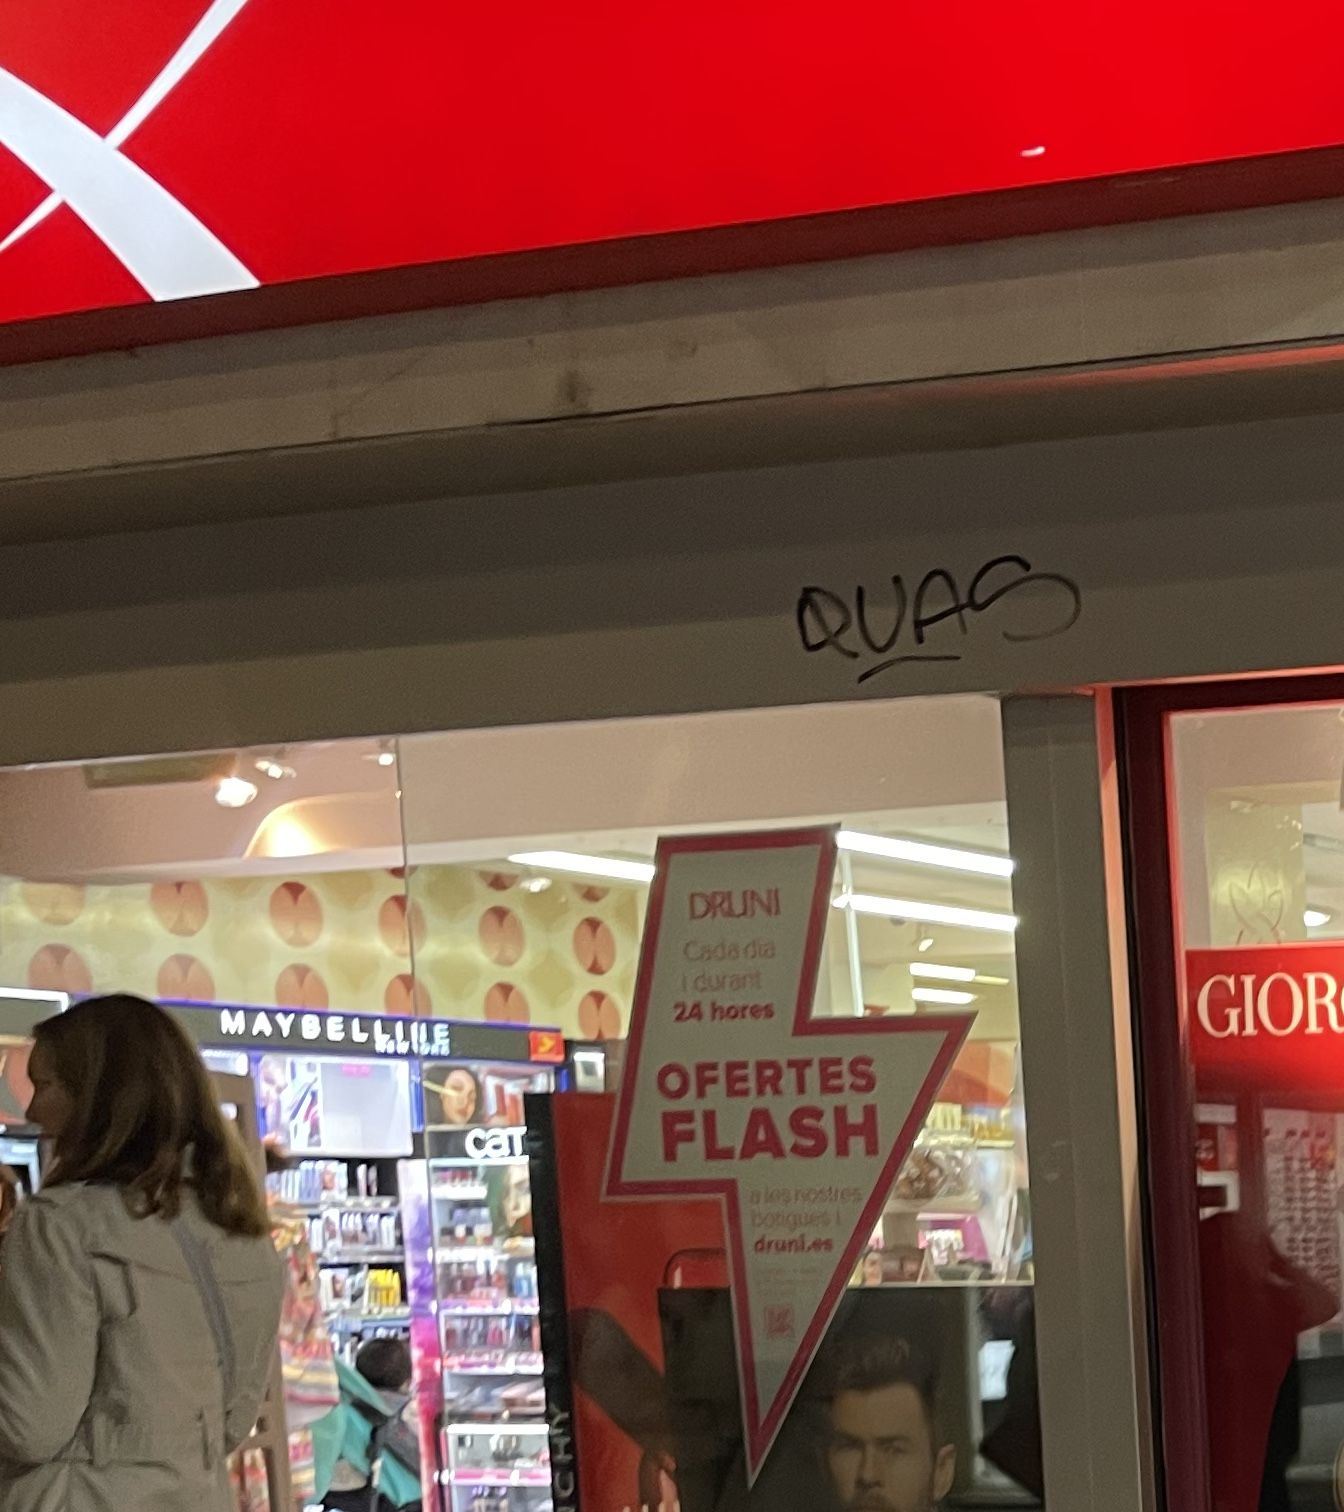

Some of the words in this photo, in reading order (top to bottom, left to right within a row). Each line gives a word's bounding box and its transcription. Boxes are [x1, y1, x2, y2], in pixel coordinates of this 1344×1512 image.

[689, 888, 781, 920] DRUNI
[673, 1001, 703, 1022] 24
[711, 1002, 775, 1022] hores
[657, 1055, 877, 1101] OFERTES
[661, 1103, 879, 1163] FLASH
[754, 1234, 833, 1253] druni.es
